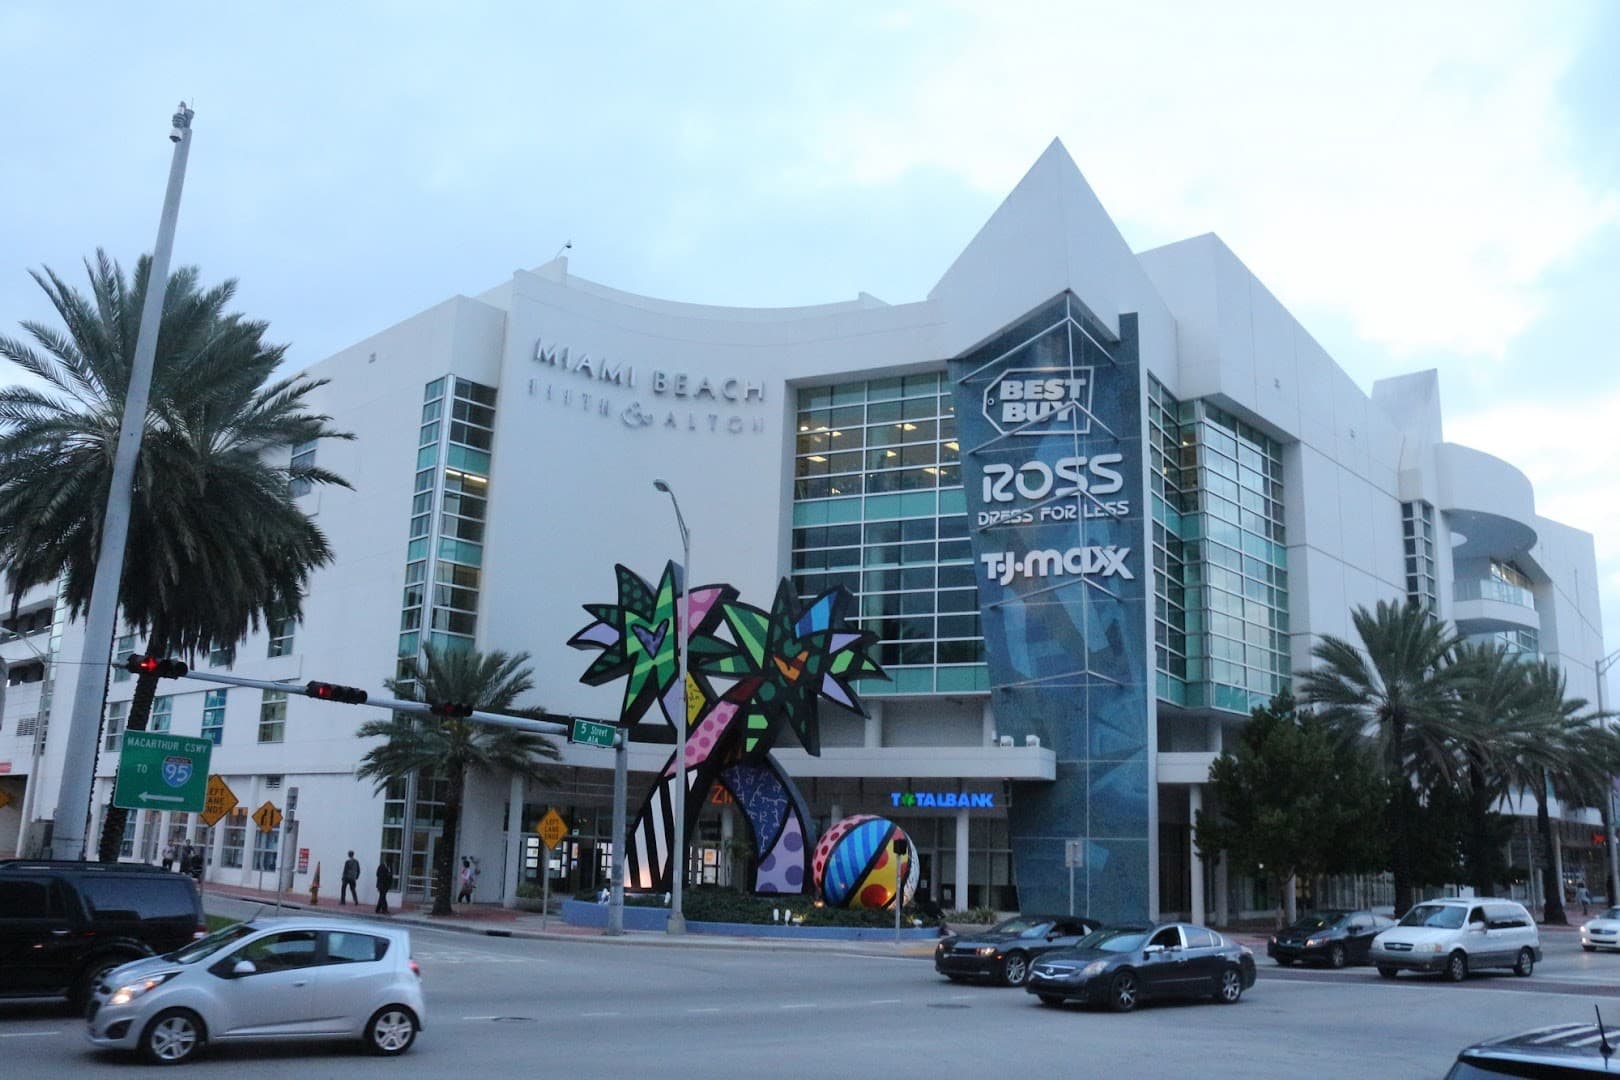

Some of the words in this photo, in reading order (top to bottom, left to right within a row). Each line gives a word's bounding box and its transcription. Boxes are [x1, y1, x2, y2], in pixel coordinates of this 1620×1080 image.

[533, 338, 637, 388] MIAMI
[652, 370, 766, 402] BEACH
[1000, 379, 1086, 400] BEST
[621, 401, 653, 428] &
[1002, 401, 1073, 423] BUY
[982, 453, 1124, 503] ROSS
[978, 508, 1034, 526] DRESS
[1040, 504, 1077, 521] FOR
[1084, 501, 1129, 518] LESS
[581, 723, 587, 735] 5
[590, 725, 608, 737] Street
[127, 736, 180, 751] MACARTHUR
[184, 742, 207, 753] CSWY
[137, 763, 148, 774] TO
[165, 764, 189, 782] 95
[209, 788, 225, 796] EFT
[891, 792, 993, 808] TOTALBANK
